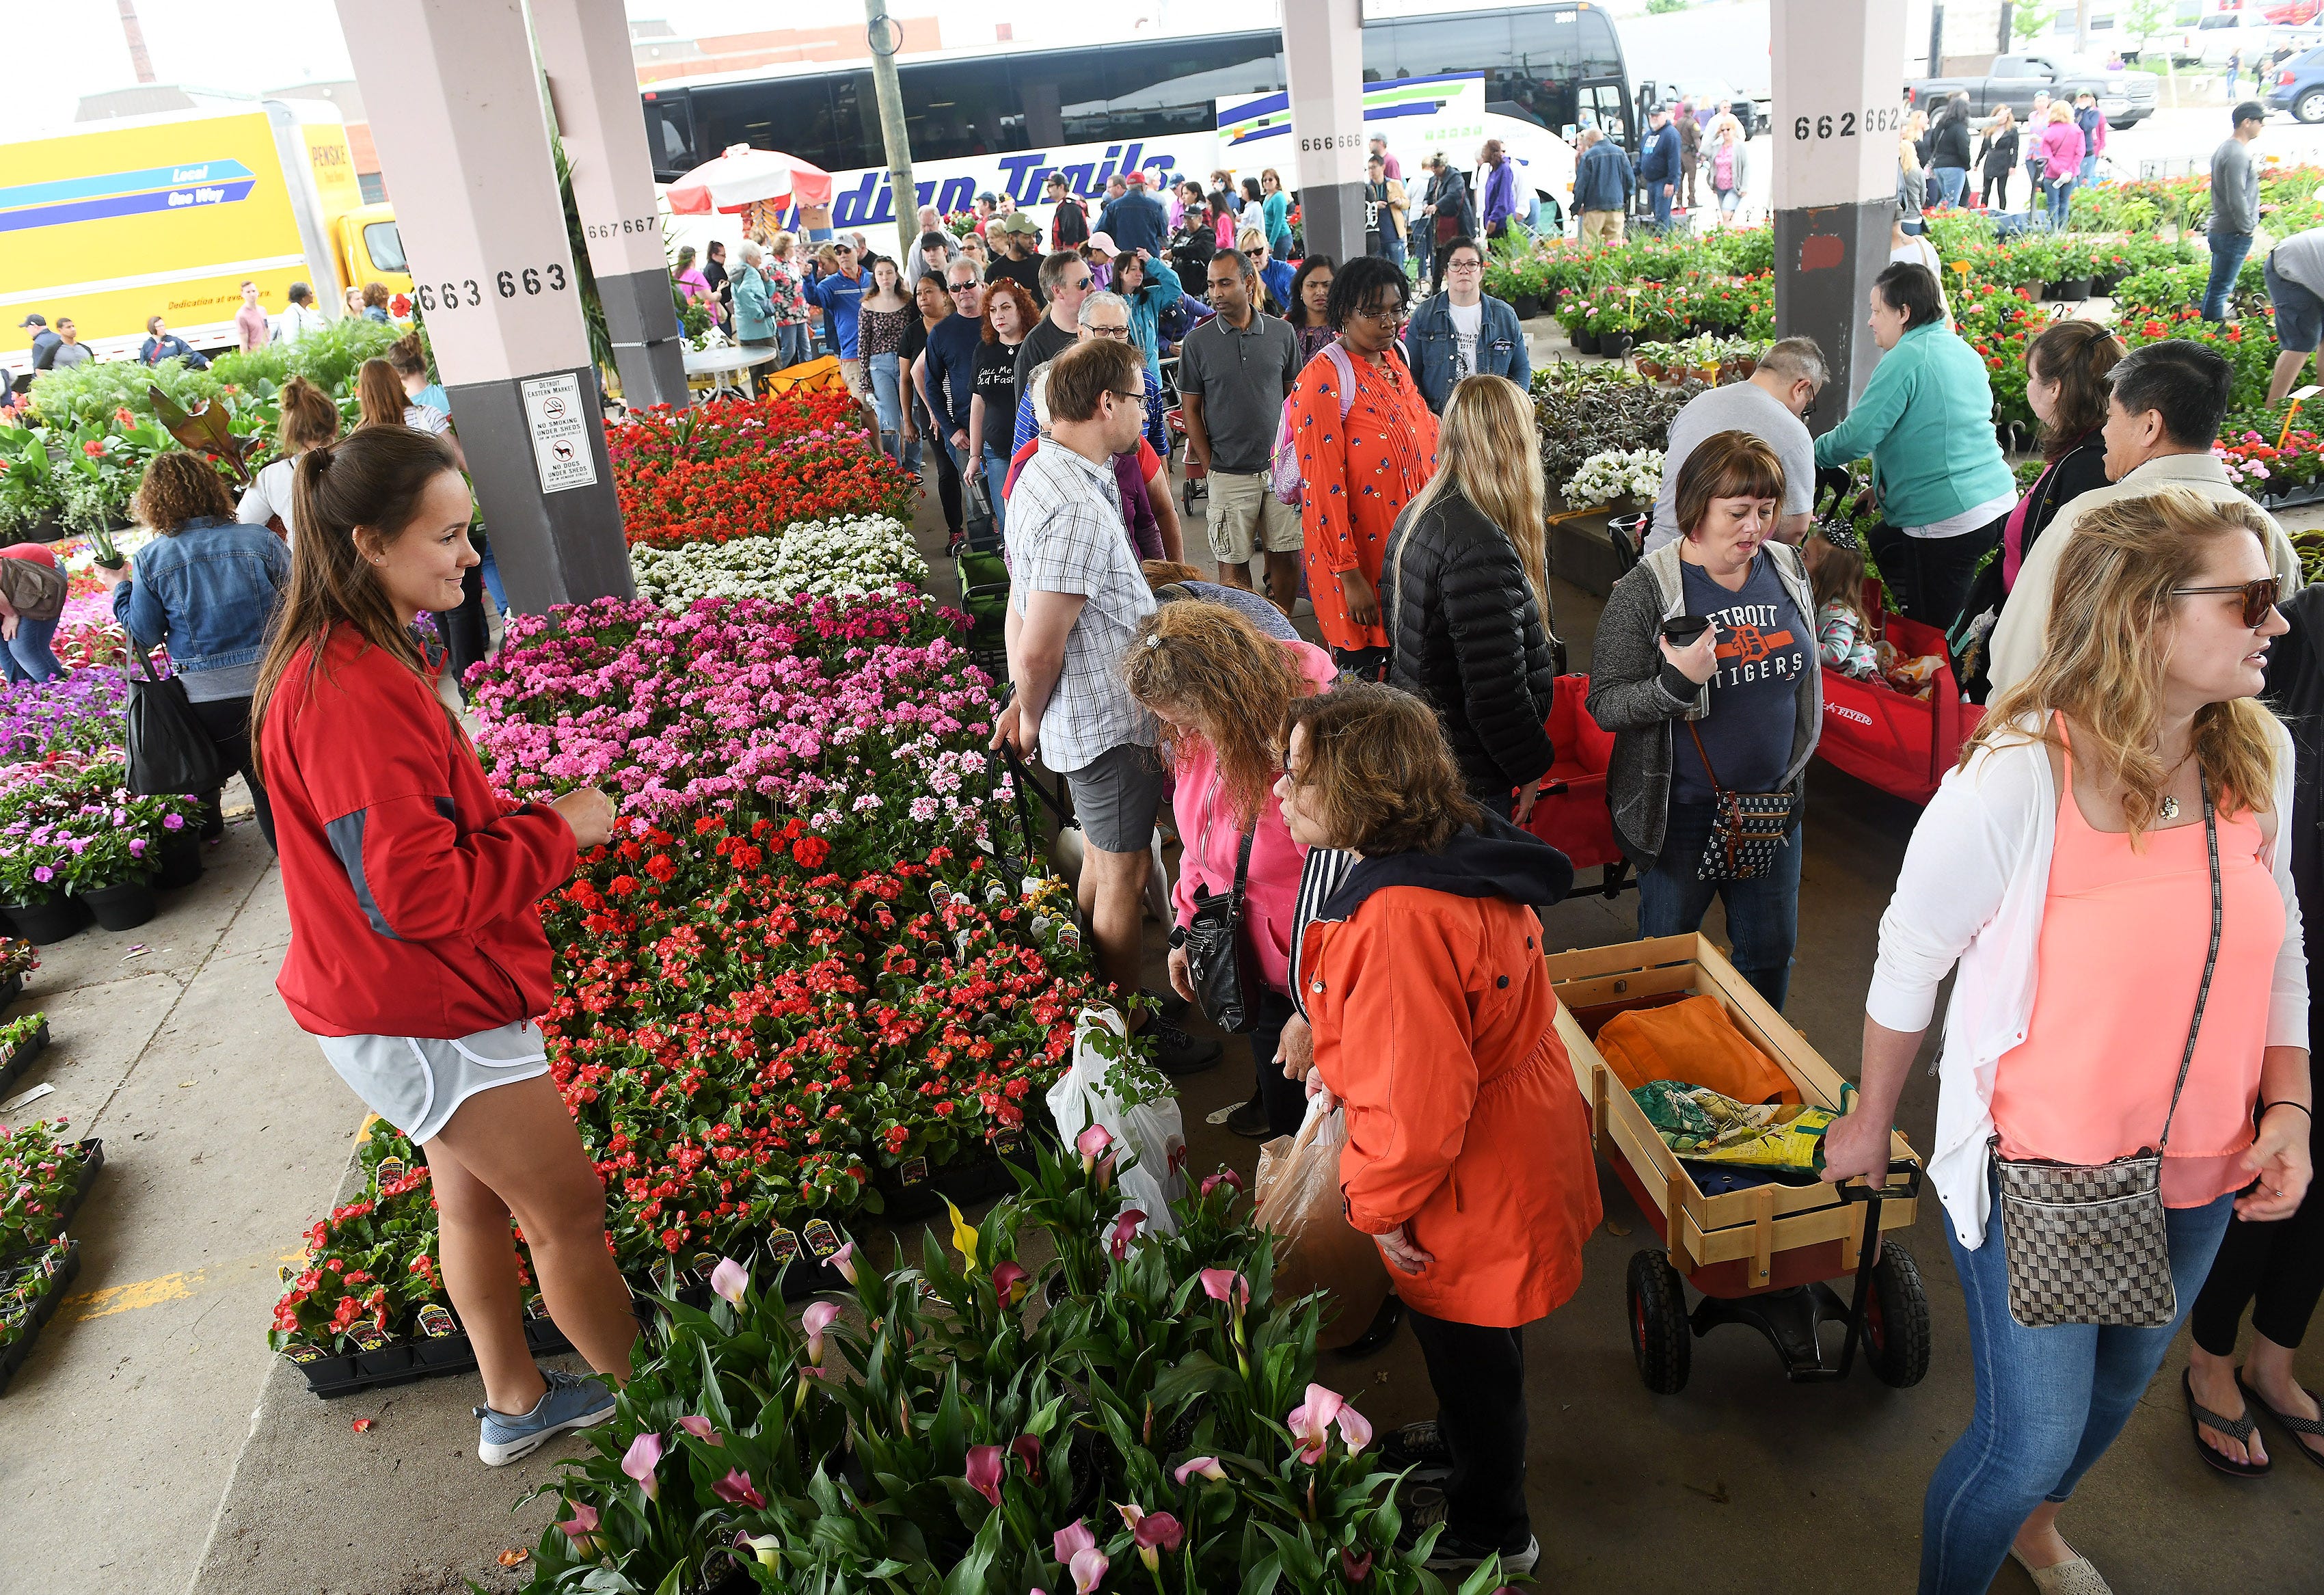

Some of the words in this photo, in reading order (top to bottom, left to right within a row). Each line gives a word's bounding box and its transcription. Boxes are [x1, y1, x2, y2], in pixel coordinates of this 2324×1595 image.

[1794, 112, 1856, 140] 662
[1865, 107, 1899, 132] 662
[1301, 137, 1333, 152] 666
[1338, 134, 1361, 148] 666
[312, 145, 346, 167] PENSKE
[172, 164, 208, 183] Local
[998, 143, 1175, 208] Trails
[167, 191, 194, 206] One
[195, 187, 225, 204] Way
[588, 223, 619, 239] 667
[623, 217, 655, 233] 667
[496, 263, 567, 298] 663
[168, 298, 213, 310] Dedication
[418, 280, 481, 311] 663
[999, 365, 1012, 374] Me
[527, 389, 551, 398] EASTERN
[553, 385, 574, 393] MARKET
[539, 380, 560, 389] DETROIT
[537, 428, 558, 436] UNDER
[560, 424, 581, 432] SHEDS
[549, 418, 578, 427] SMOKING
[1705, 604, 1777, 634] ETROIT
[1713, 652, 1802, 688] TIGERS
[1837, 707, 1873, 725] FLYER
